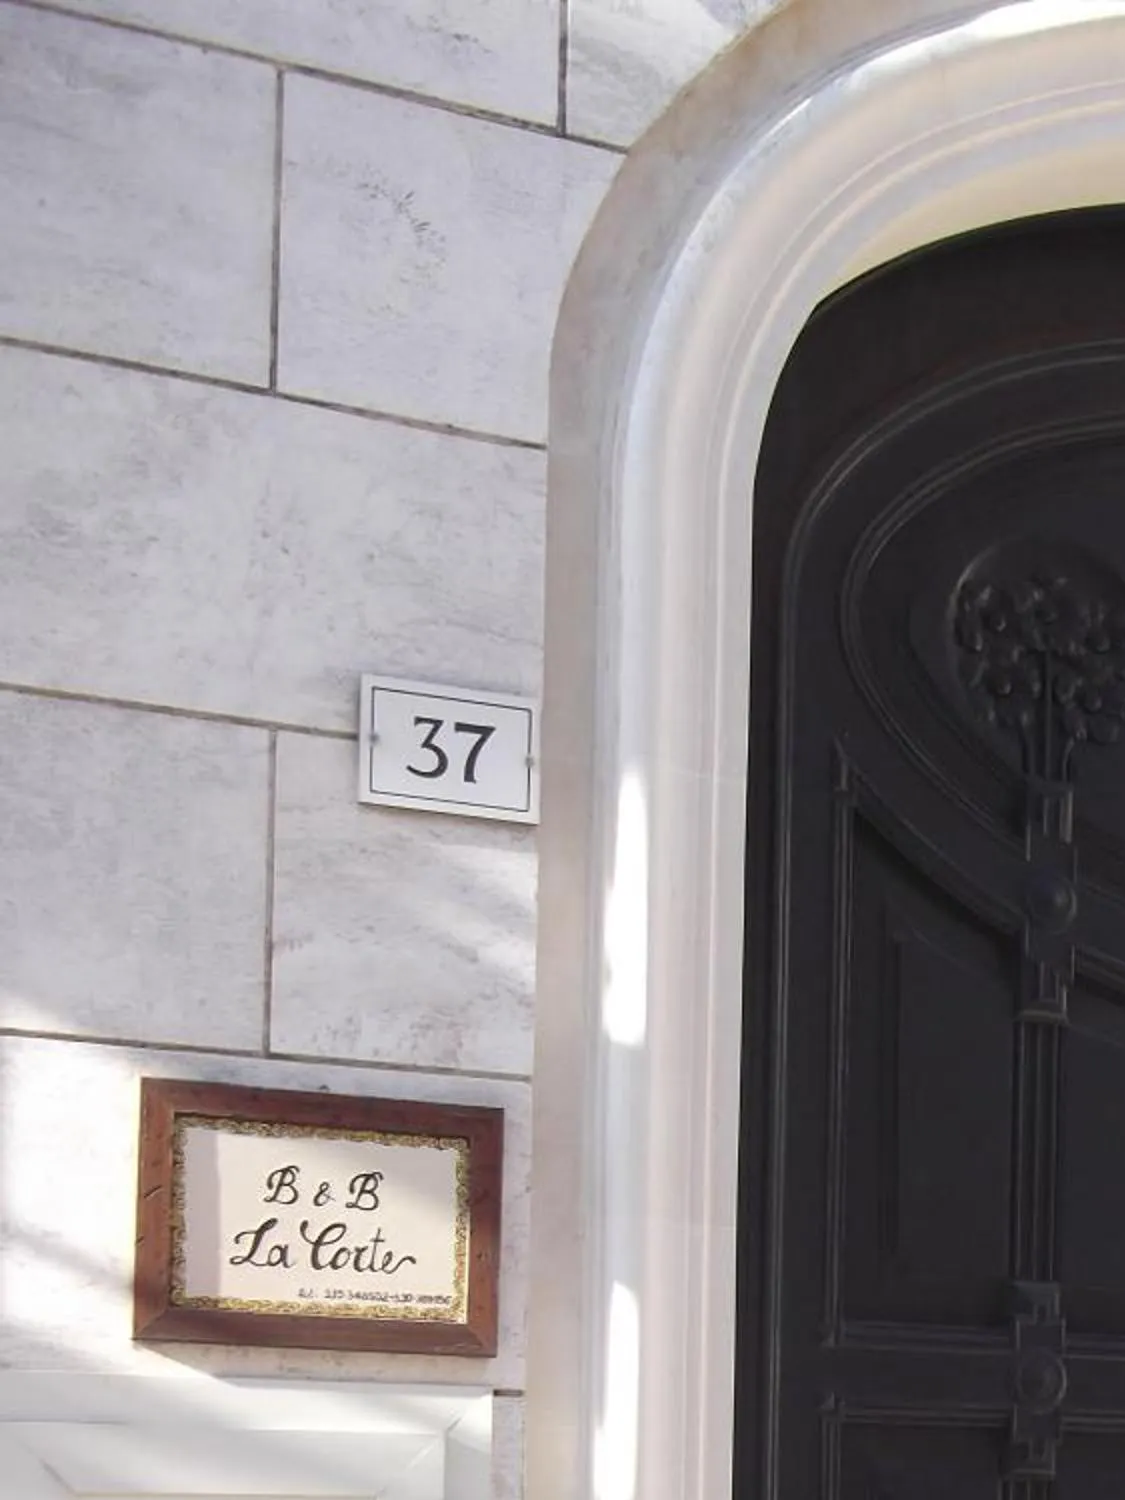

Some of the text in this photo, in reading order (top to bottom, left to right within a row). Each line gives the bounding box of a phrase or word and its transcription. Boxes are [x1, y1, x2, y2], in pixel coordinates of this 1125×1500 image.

[406, 716, 497, 784] 37
[263, 1164, 385, 1212] B & B
[229, 1217, 417, 1275] La Corte
